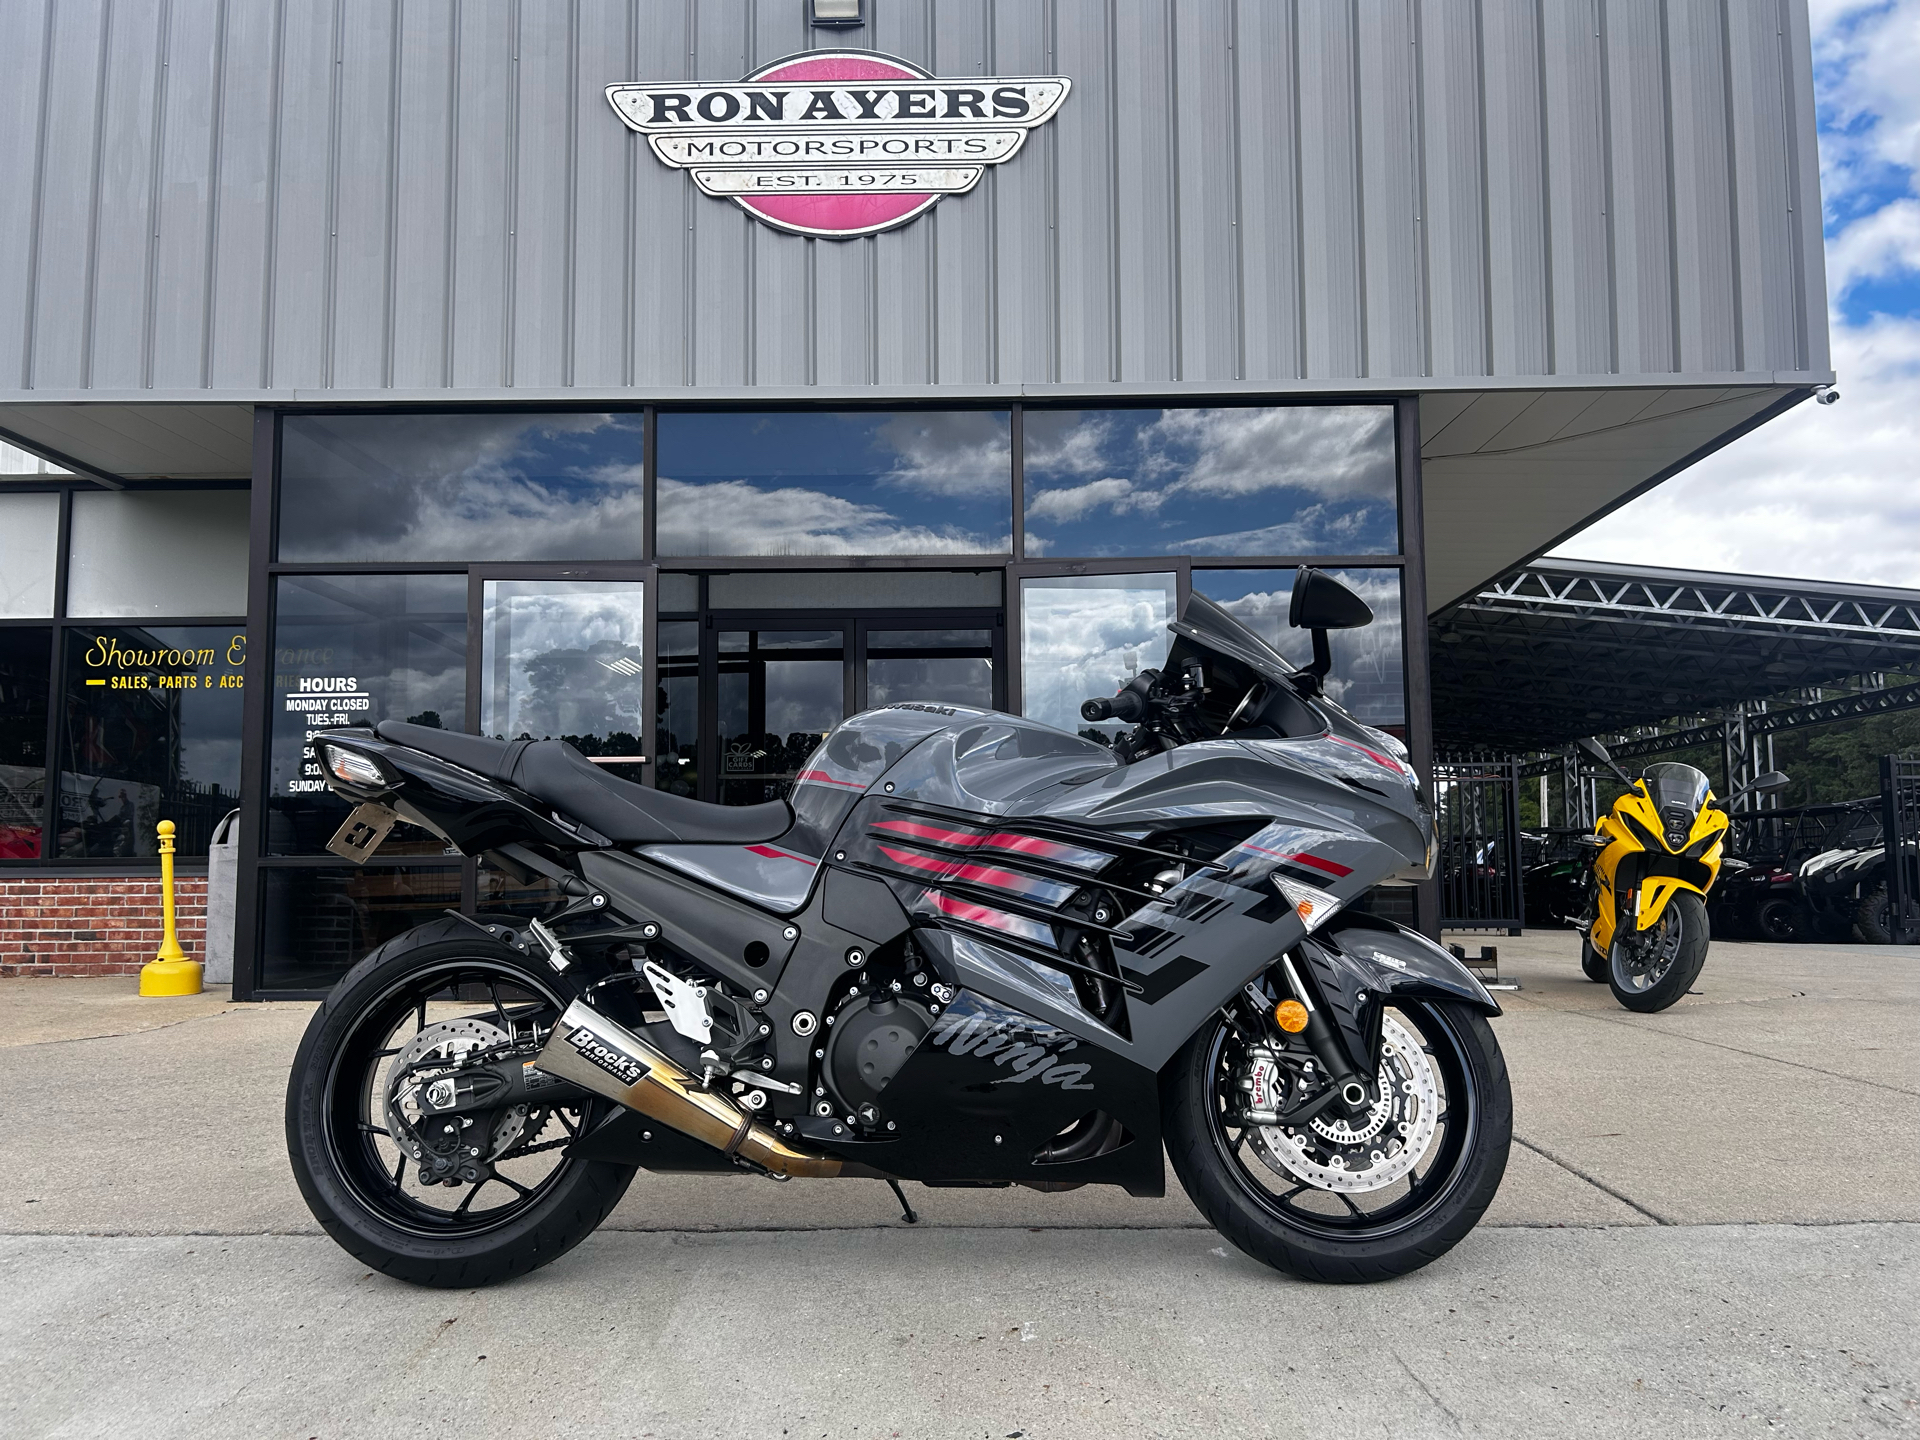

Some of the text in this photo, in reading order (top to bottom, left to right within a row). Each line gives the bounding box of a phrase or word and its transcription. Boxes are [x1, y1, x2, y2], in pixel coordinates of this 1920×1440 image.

[647, 87, 1029, 123] RON AYERS
[687, 138, 988, 157] MOTORSPORTS
[756, 174, 917, 187] EST. 1975
[86, 636, 215, 670] Showroom
[111, 676, 152, 690] SALES,
[159, 675, 197, 688] PARTS
[205, 675, 213, 688] &
[300, 677, 357, 692] HOURS
[286, 698, 370, 711] MONDAY CLOSED
[306, 713, 350, 725] TUES.-FRI.
[289, 780, 326, 792] SUNDAY
[570, 1028, 641, 1078] Brock's
[932, 1010, 1095, 1090] Ninja
[580, 1048, 633, 1082] PERFORMANCE
[1254, 1065, 1265, 1104] brembo
